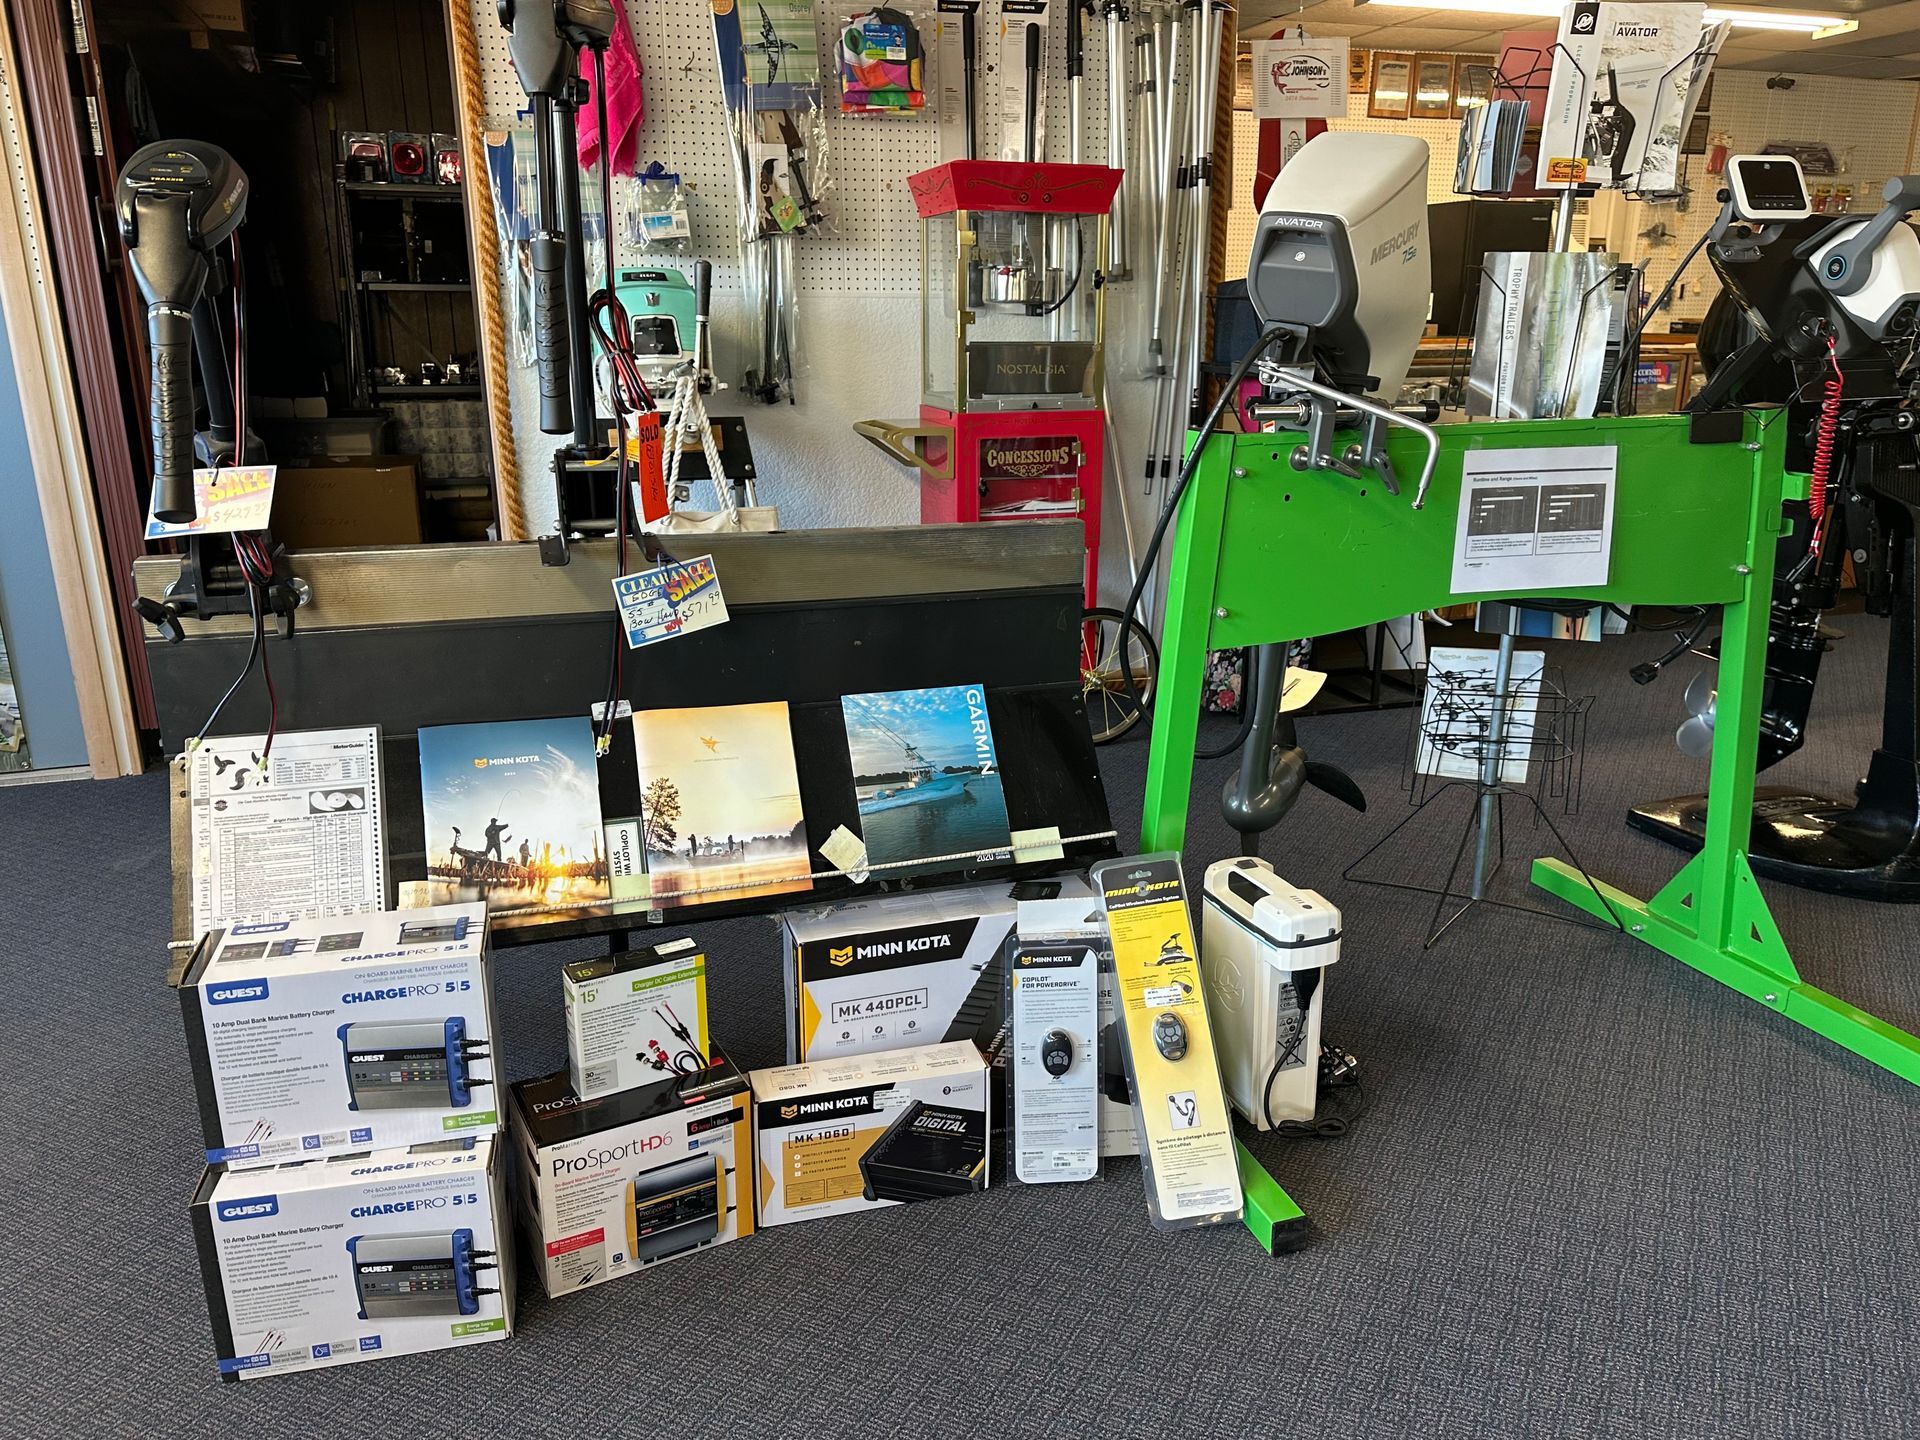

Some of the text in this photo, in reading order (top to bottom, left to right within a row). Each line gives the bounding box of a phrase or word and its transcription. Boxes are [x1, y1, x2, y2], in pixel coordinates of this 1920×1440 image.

[1616, 28, 1658, 37] AVATOR
[1275, 218, 1323, 228] AVATOR
[1370, 220, 1420, 266] MERCURY
[1504, 268, 1522, 340] TROPHY TRAILERS
[640, 424, 658, 444] SOLD
[987, 446, 1069, 468] CONCESSIONS
[207, 480, 270, 502] SALE
[665, 566, 716, 602] SALE
[664, 617, 684, 632] NOW
[489, 755, 540, 767] MINN KOTA
[620, 830, 630, 862] COPILOT
[857, 934, 951, 960] MINN KOTA
[415, 965, 438, 973] BATTERY
[440, 962, 468, 970] CHARGER
[212, 986, 264, 1000] GUEST
[839, 995, 921, 1017] MK 440PCL
[268, 1014, 288, 1022] Marine
[312, 1009, 335, 1017] Charger
[352, 1054, 385, 1062] GUEST
[800, 1096, 869, 1114] MINN KOTA
[913, 1116, 967, 1133] DIGITAL
[795, 1133, 814, 1144] MK
[398, 1182, 421, 1190] MARINE
[422, 1179, 446, 1187] BATTERY
[448, 1176, 474, 1184] CHARGER
[223, 1202, 273, 1217] GUEST
[231, 1236, 246, 1244] Amp
[321, 1223, 344, 1231] Charger
[361, 1265, 393, 1273] GUEST
